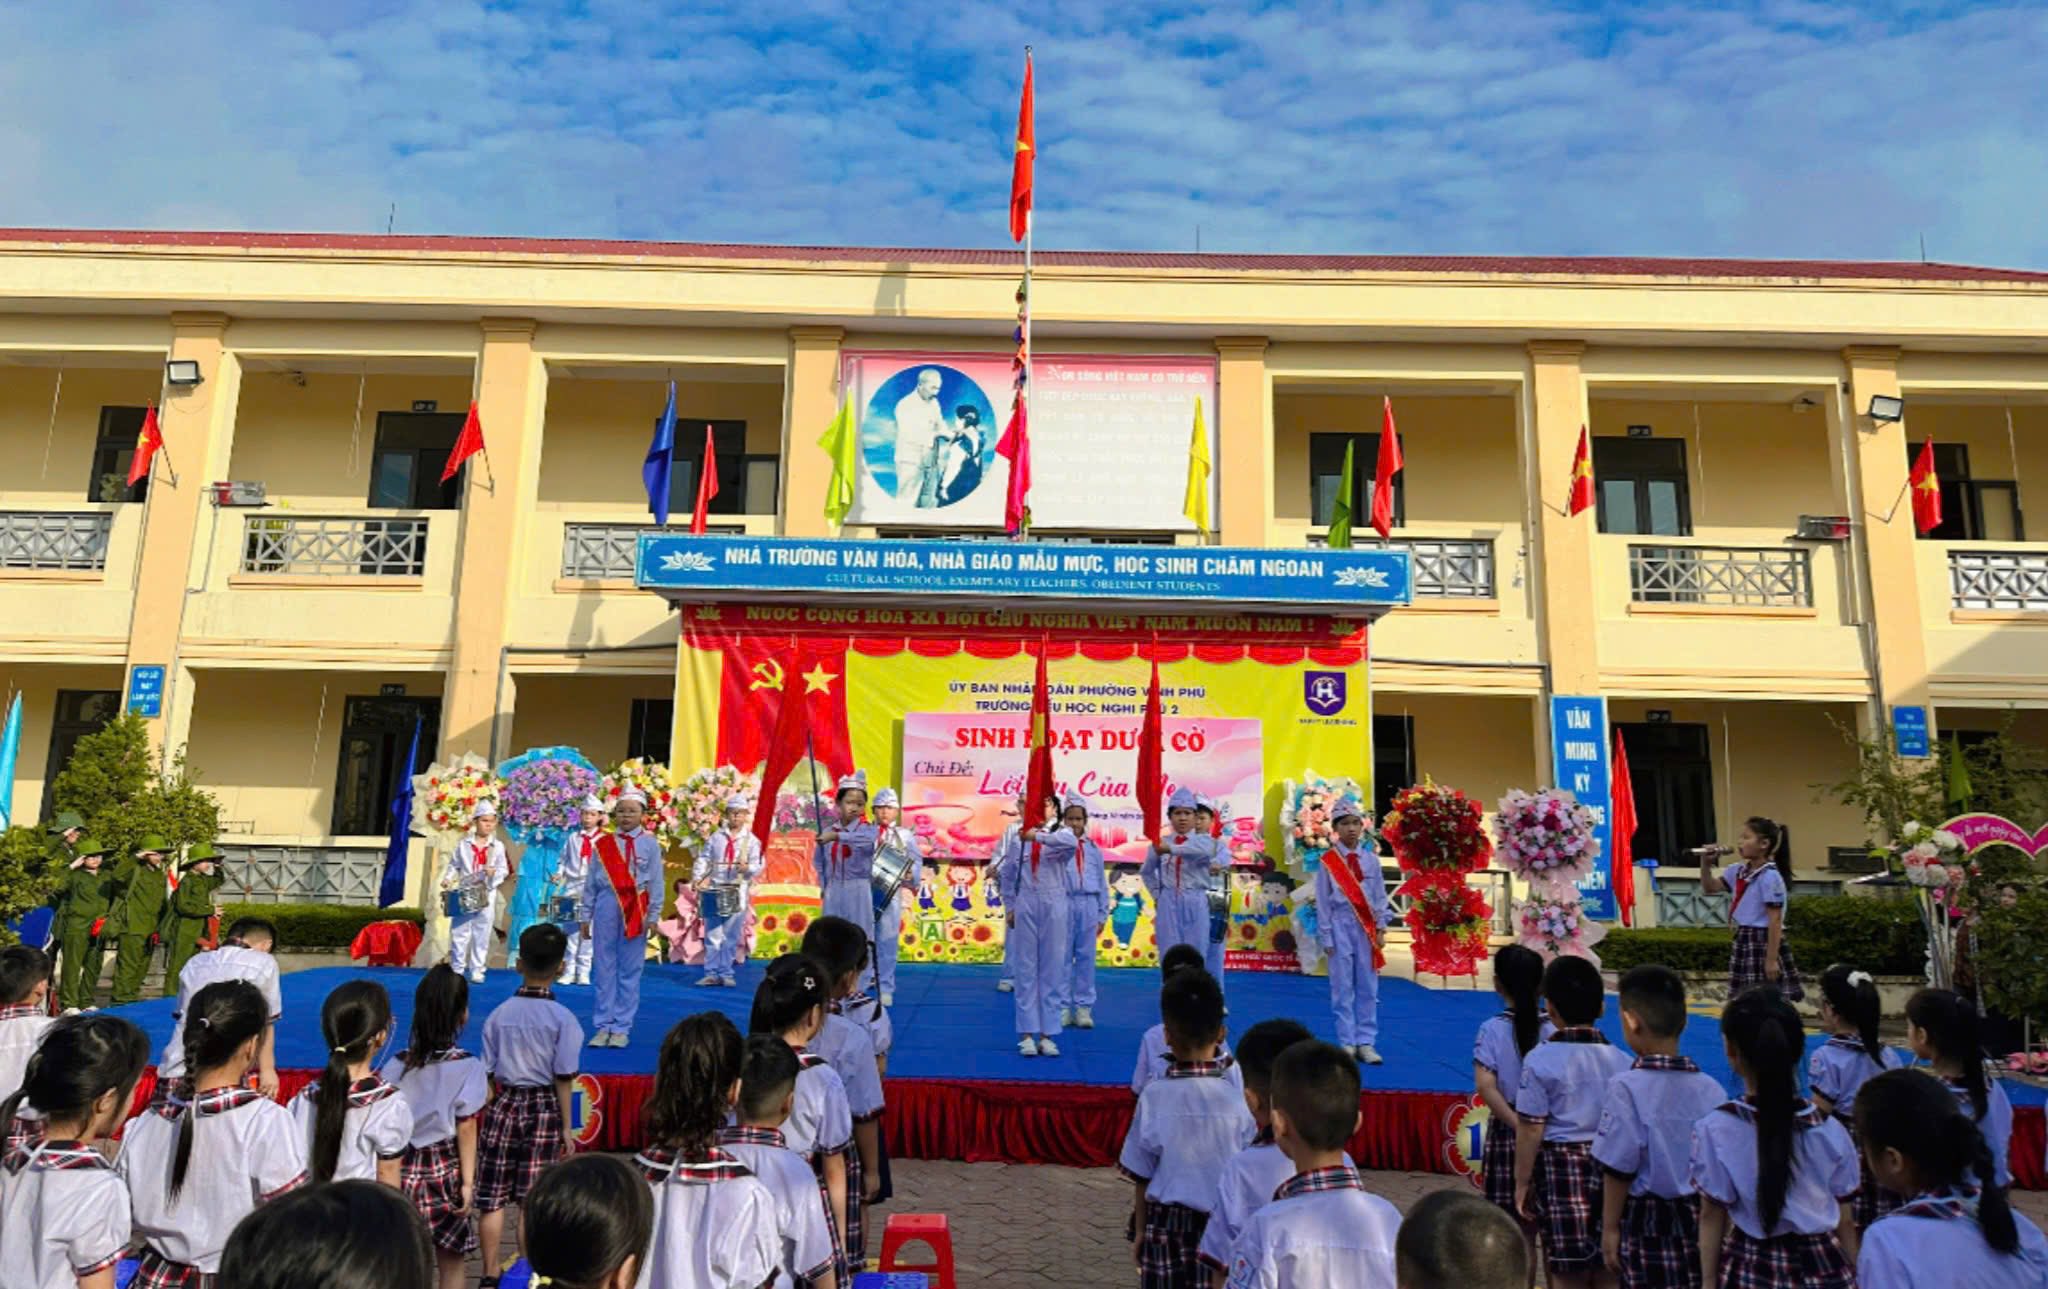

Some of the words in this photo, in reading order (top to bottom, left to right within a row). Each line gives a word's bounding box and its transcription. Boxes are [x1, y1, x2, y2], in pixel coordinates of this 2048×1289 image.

[768, 545, 837, 566] TRƯỜNG
[843, 546, 878, 568] VĂN
[883, 548, 924, 570] HÓA,
[929, 549, 966, 570] NHÀ
[971, 550, 1013, 571] GIÁO
[1018, 549, 1058, 572] MẪU
[1064, 554, 1108, 576] MỰC,
[1114, 556, 1149, 576] HỌC
[1155, 557, 1197, 575] SINH
[1261, 559, 1324, 577] NGOAN
[825, 573, 890, 584] CULTURAL
[950, 576, 1020, 587] EXEMPLARY
[1157, 580, 1221, 591] STUDENTS
[1145, 616, 1188, 631] NAM
[970, 683, 998, 693] BAN
[1079, 683, 1137, 696] PHƯỜNG
[1141, 686, 1174, 697] VNH
[975, 699, 1032, 712] TRƯỜNG
[1065, 703, 1096, 716] HỌC
[1101, 704, 1135, 714] NGHI
[1171, 704, 1179, 715] 2
[1565, 706, 1591, 729] VĂN
[955, 728, 1016, 748] SINH
[1100, 727, 1164, 751] DƯ
[1171, 726, 1205, 752] CỜ
[1564, 742, 1598, 761] MINH
[978, 769, 1025, 795] Lời
[1078, 771, 1128, 797] Của
[925, 923, 939, 940] A
